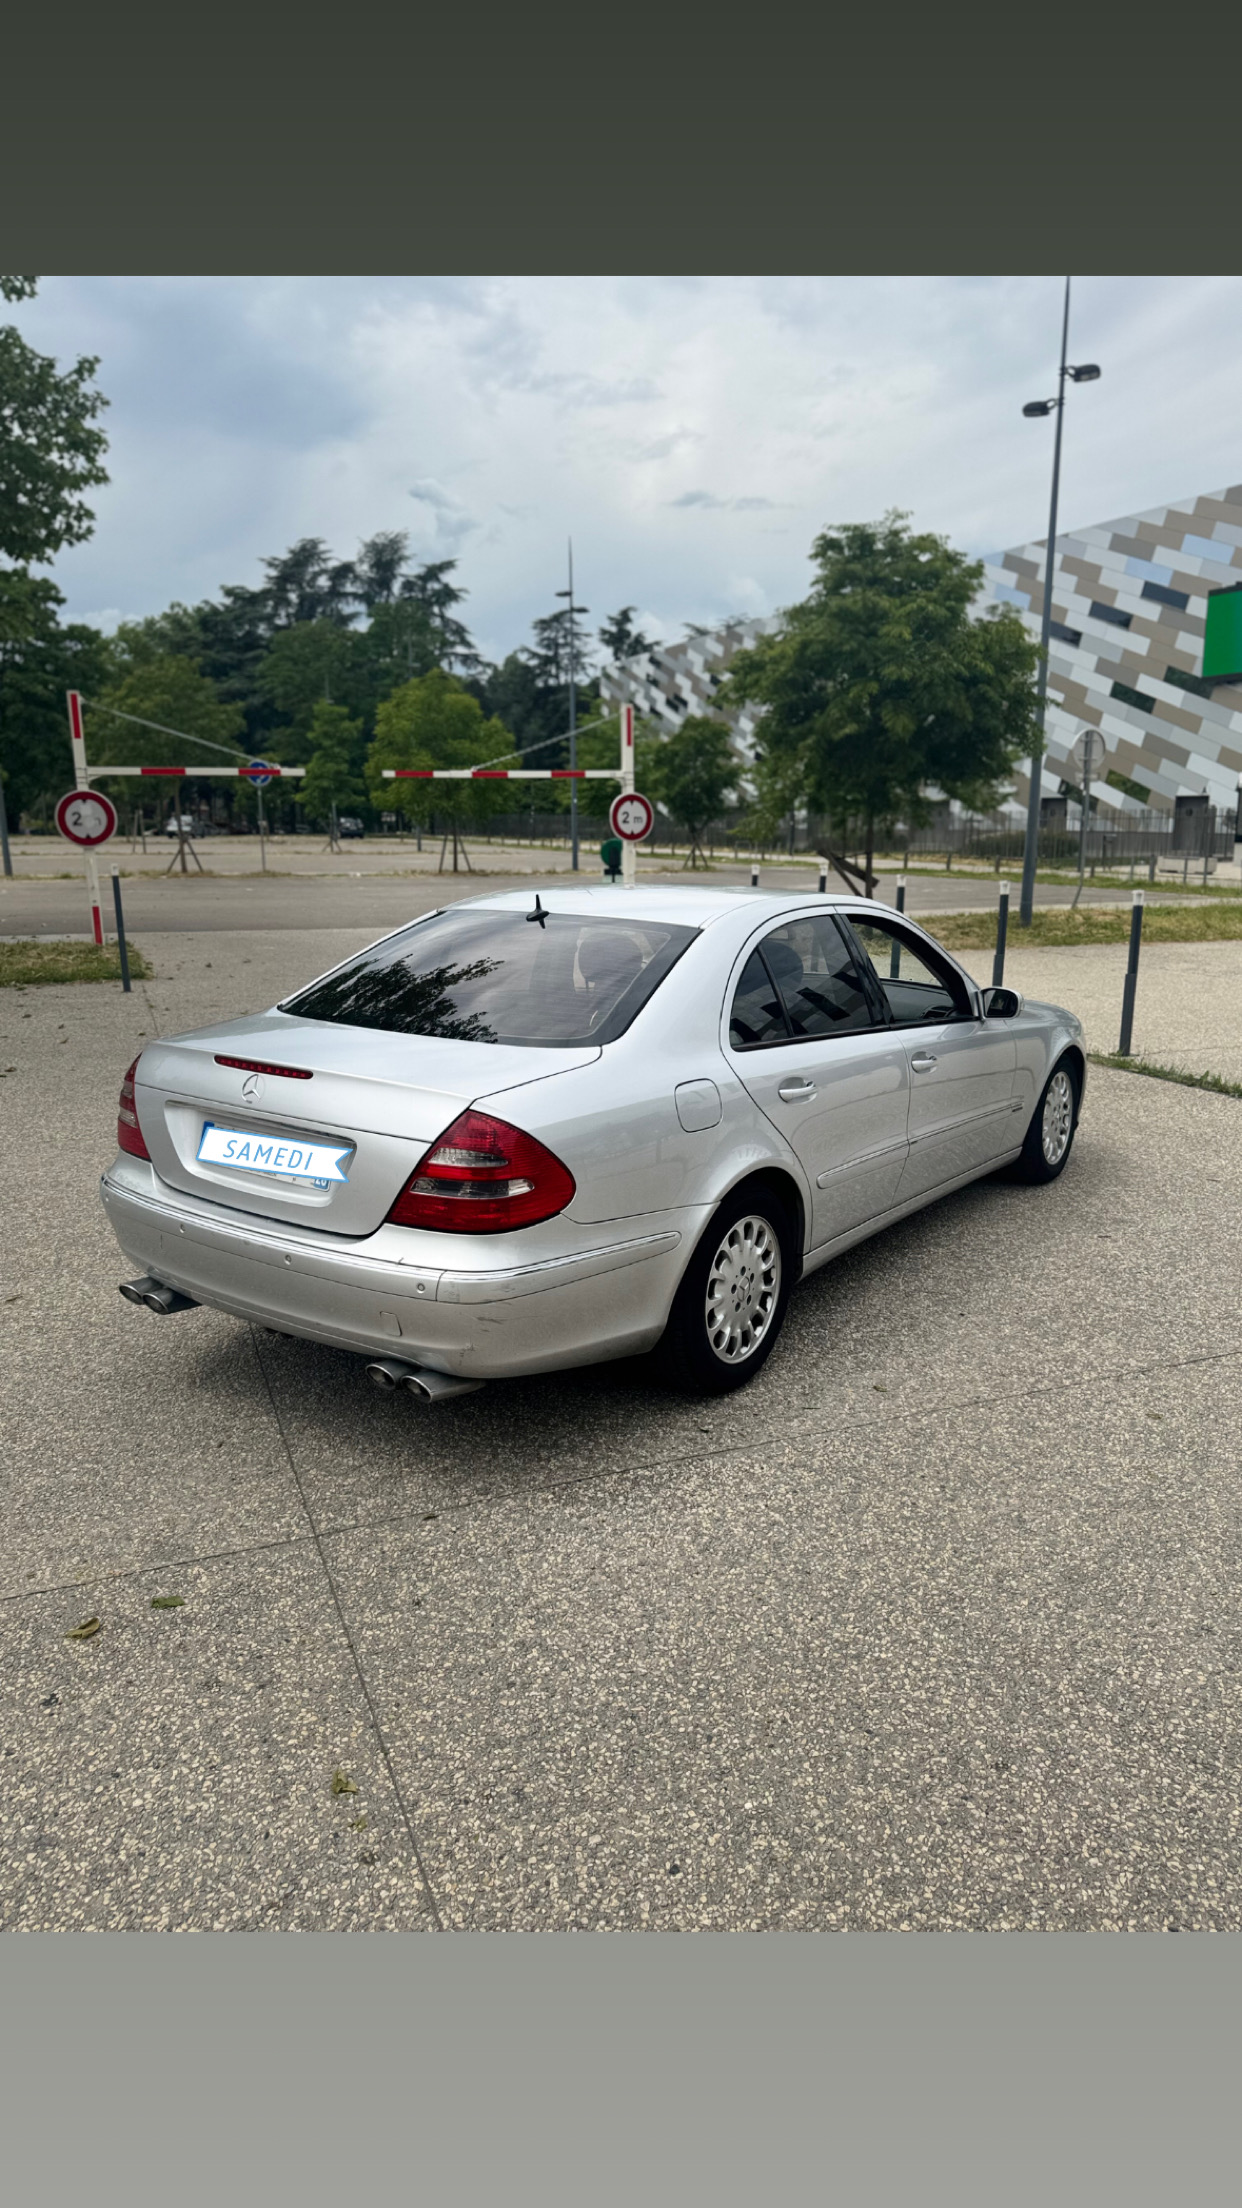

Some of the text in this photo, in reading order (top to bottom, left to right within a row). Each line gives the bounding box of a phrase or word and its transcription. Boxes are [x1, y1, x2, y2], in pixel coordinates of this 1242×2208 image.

[71, 811, 83, 826] 2
[622, 811, 644, 824] 2 m
